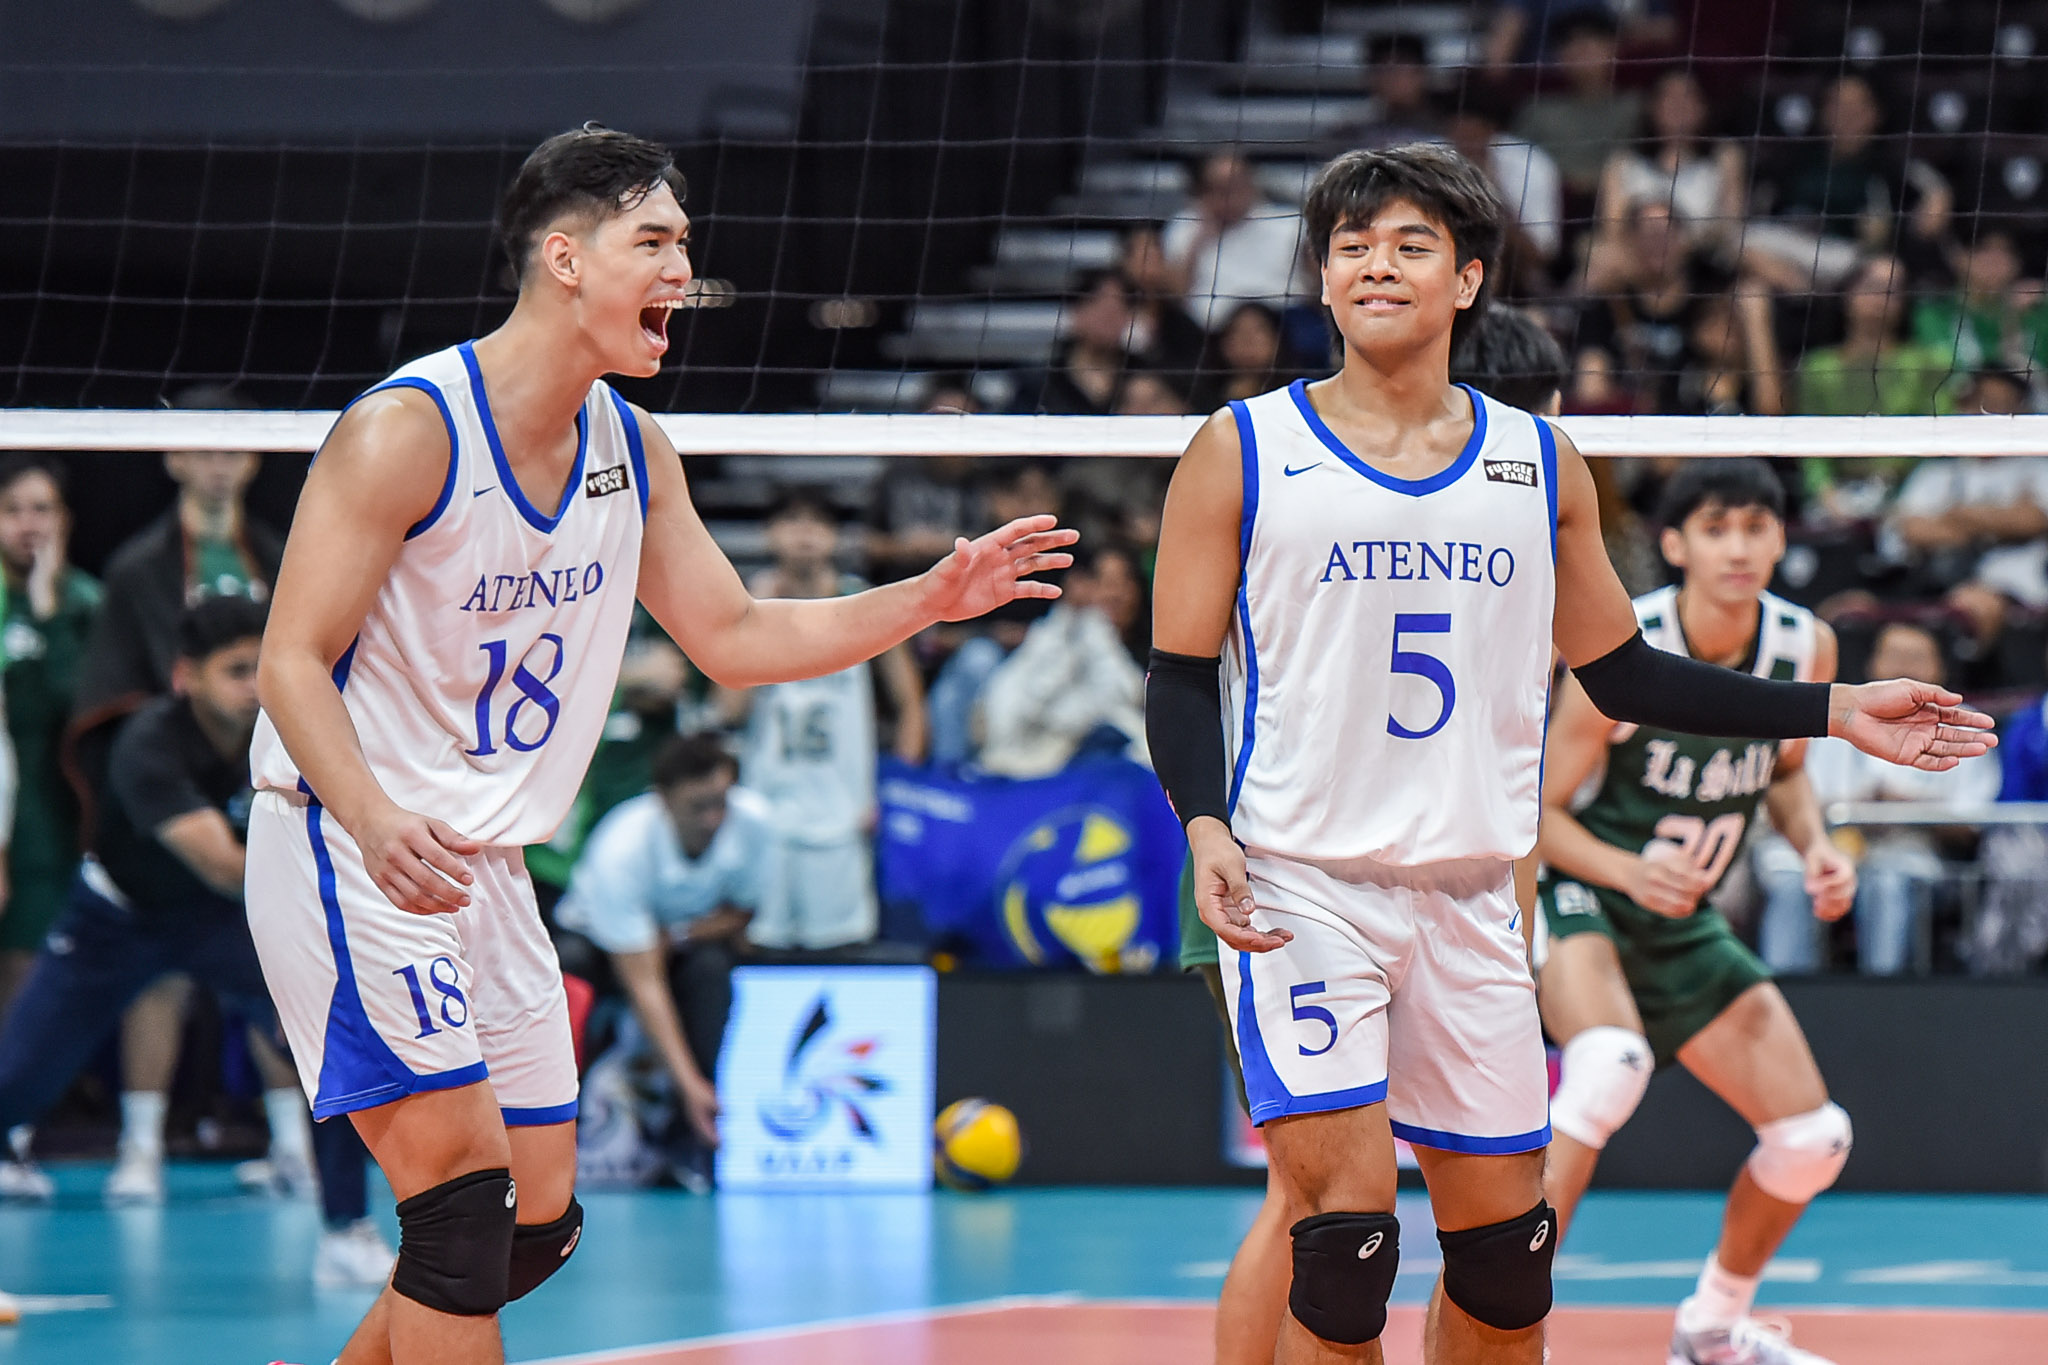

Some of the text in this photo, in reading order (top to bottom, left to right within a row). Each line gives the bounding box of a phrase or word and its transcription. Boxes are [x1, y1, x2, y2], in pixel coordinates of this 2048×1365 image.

[1486, 462, 1534, 477] FUDGEE
[459, 561, 603, 612] ATENEO
[1320, 541, 1514, 587] ATENEO
[465, 633, 563, 756] 18
[1386, 613, 1456, 739] 5
[1696, 741, 1777, 802] Sall
[392, 957, 468, 1039] 18
[1290, 981, 1338, 1056] 5
